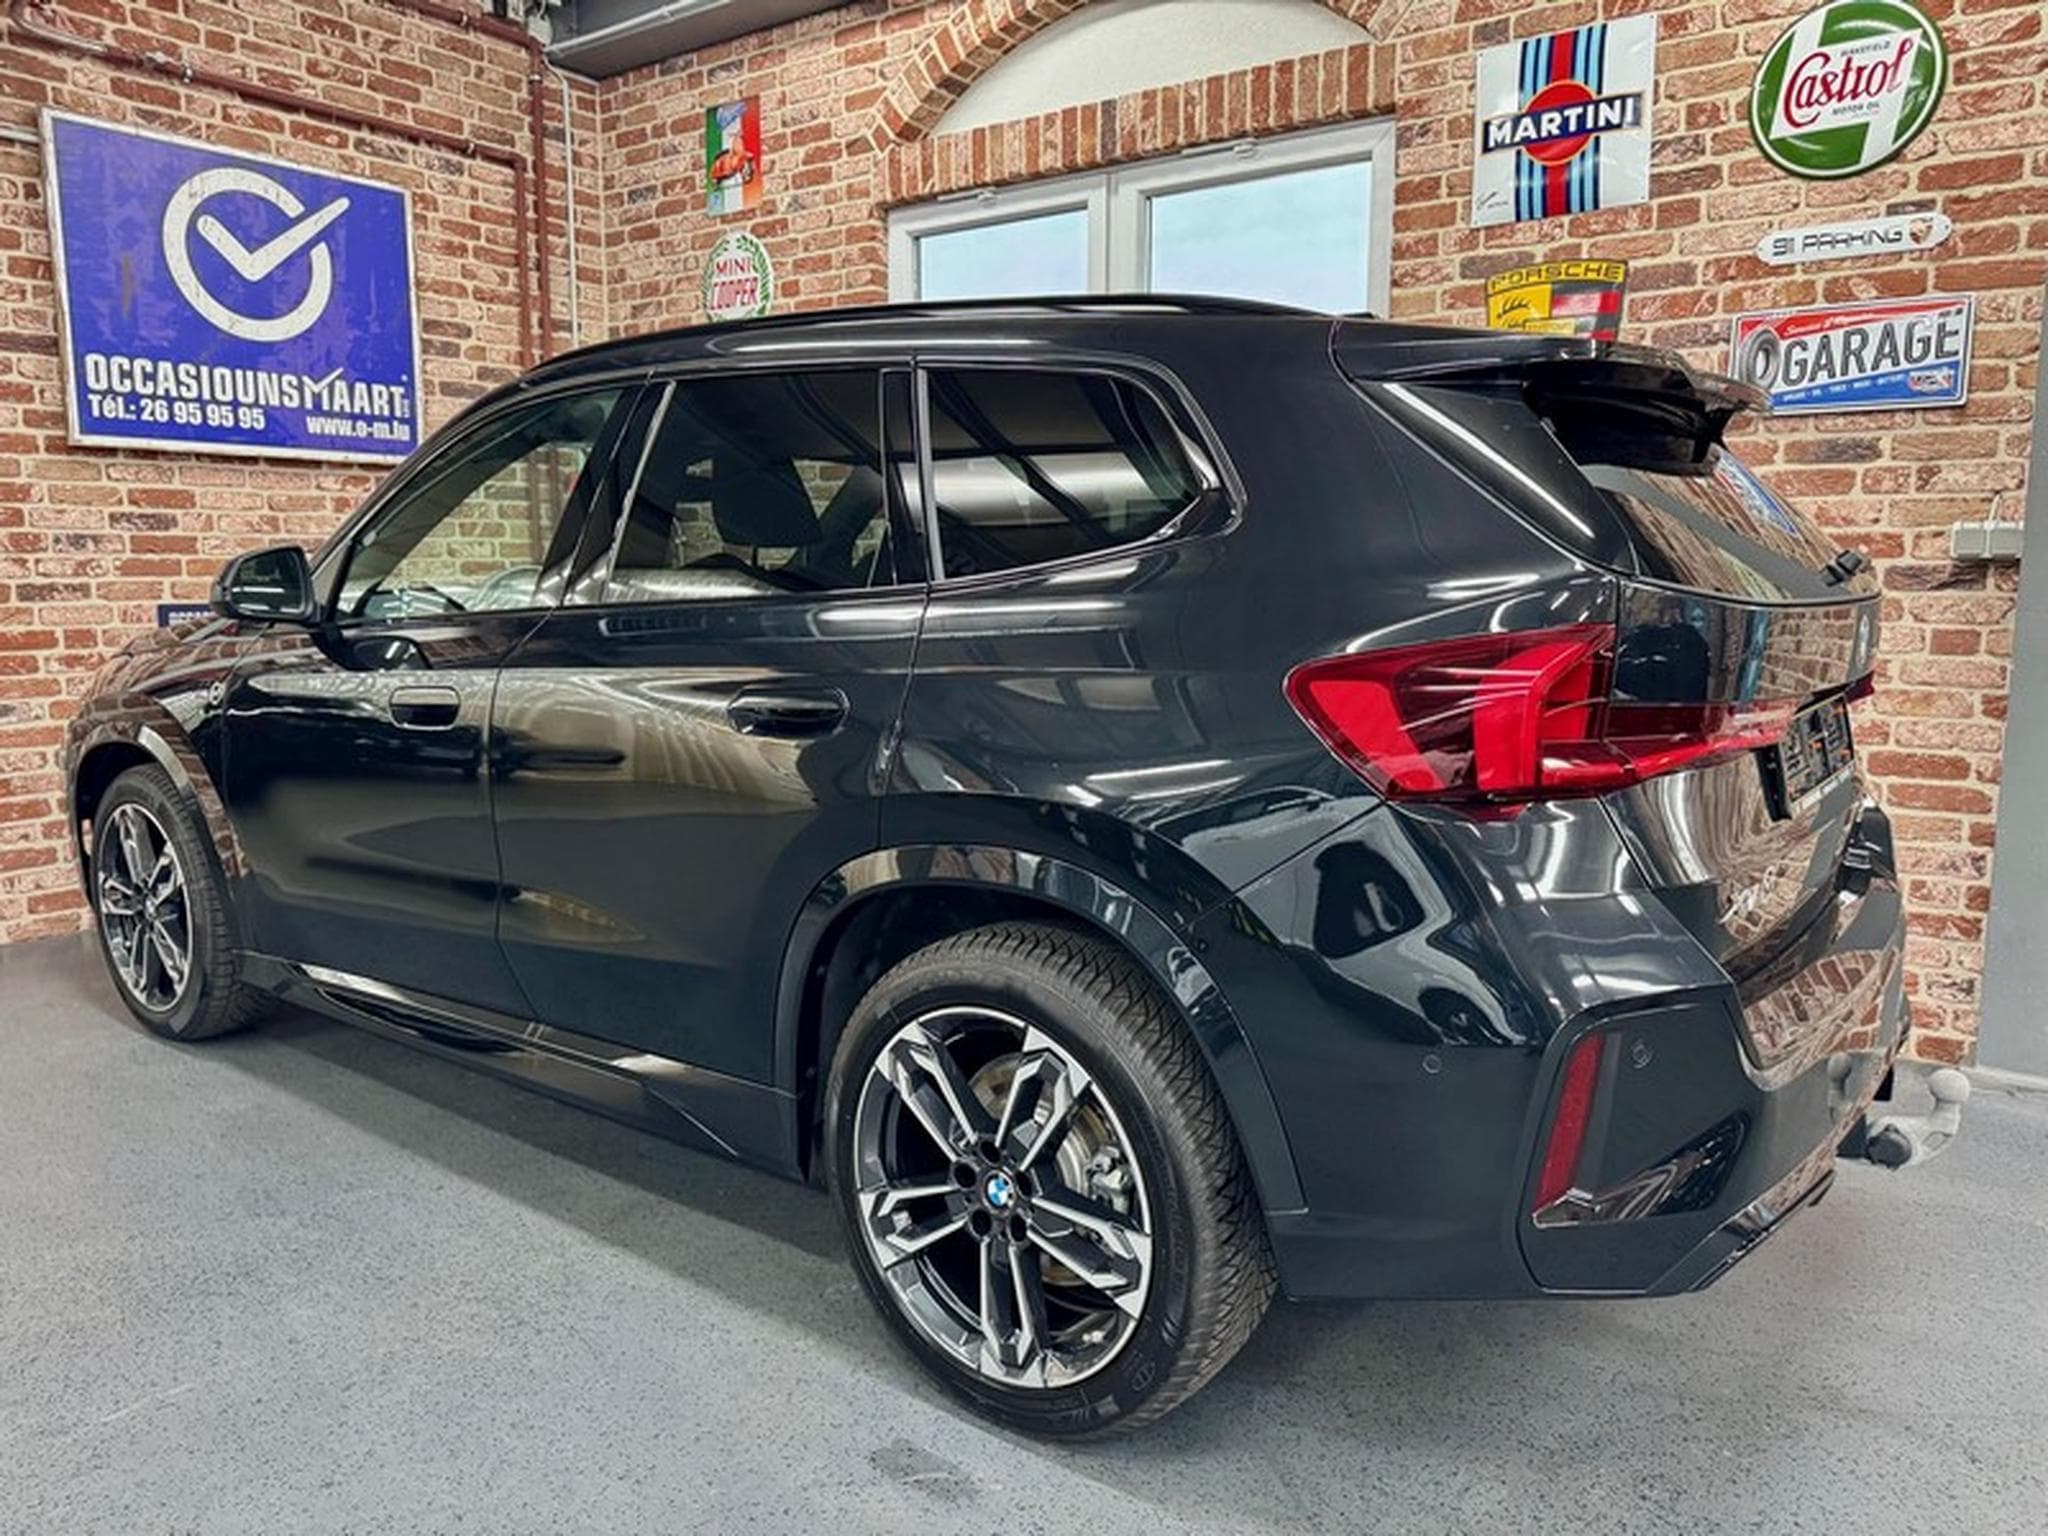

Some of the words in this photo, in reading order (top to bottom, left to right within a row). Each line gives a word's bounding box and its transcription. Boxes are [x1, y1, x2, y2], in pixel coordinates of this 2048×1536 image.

[1784, 38, 1914, 128] Castrol
[1487, 96, 1635, 149] MARTINI
[1802, 224, 1904, 252] PARKING
[716, 256, 752, 278] MINI
[1490, 263, 1624, 291] PORSCHE
[710, 277, 759, 310] COOPER
[1782, 308, 1963, 387] GARAGE
[139, 398, 169, 423] 26
[173, 401, 203, 425] 95
[205, 403, 236, 428] 95
[238, 406, 266, 430] 95
